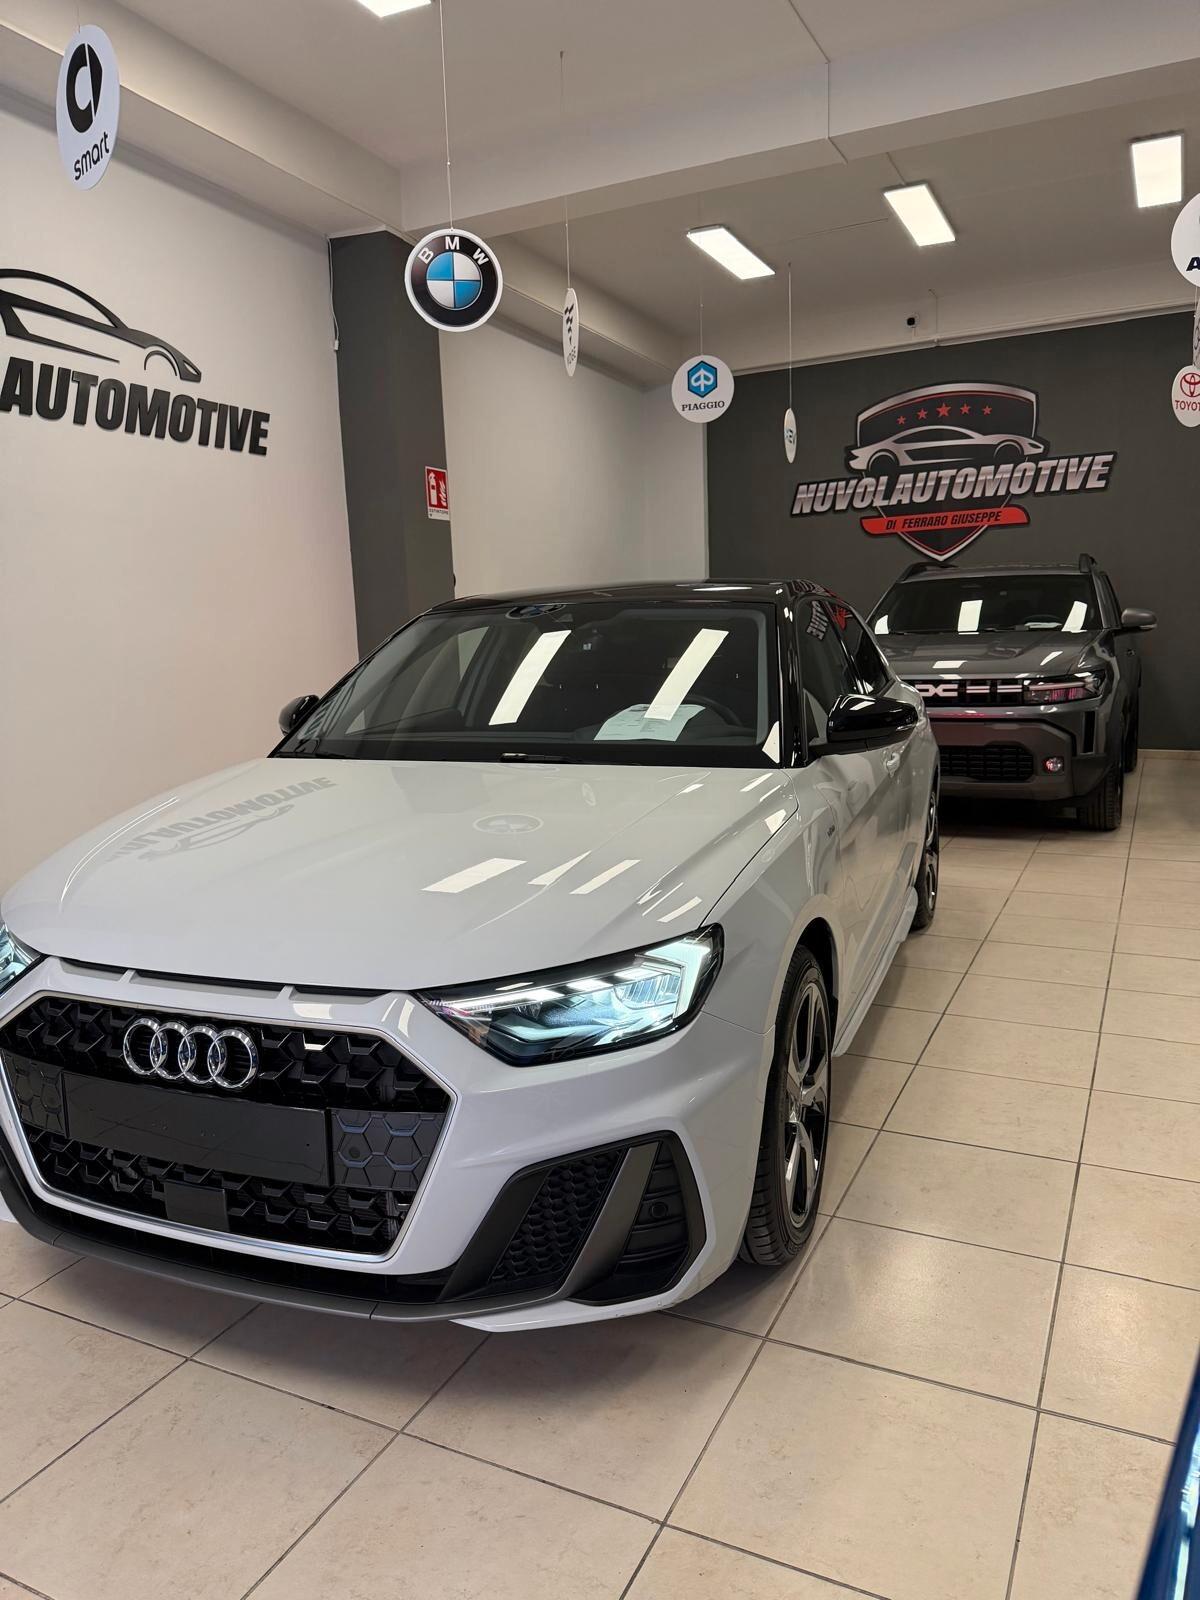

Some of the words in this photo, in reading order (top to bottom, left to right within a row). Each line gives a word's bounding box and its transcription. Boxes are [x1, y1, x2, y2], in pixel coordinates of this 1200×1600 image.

[74, 131, 109, 180] smart
[418, 236, 489, 265] BMW
[0, 356, 270, 456] AUTOMOTIVE
[681, 400, 725, 411] PIAGGIO
[792, 454, 1114, 515] NUVOLAUTOMOTIVE
[885, 519, 896, 530] DI
[902, 514, 947, 529] FERRARO
[951, 511, 1002, 525] GIUSEPPE
